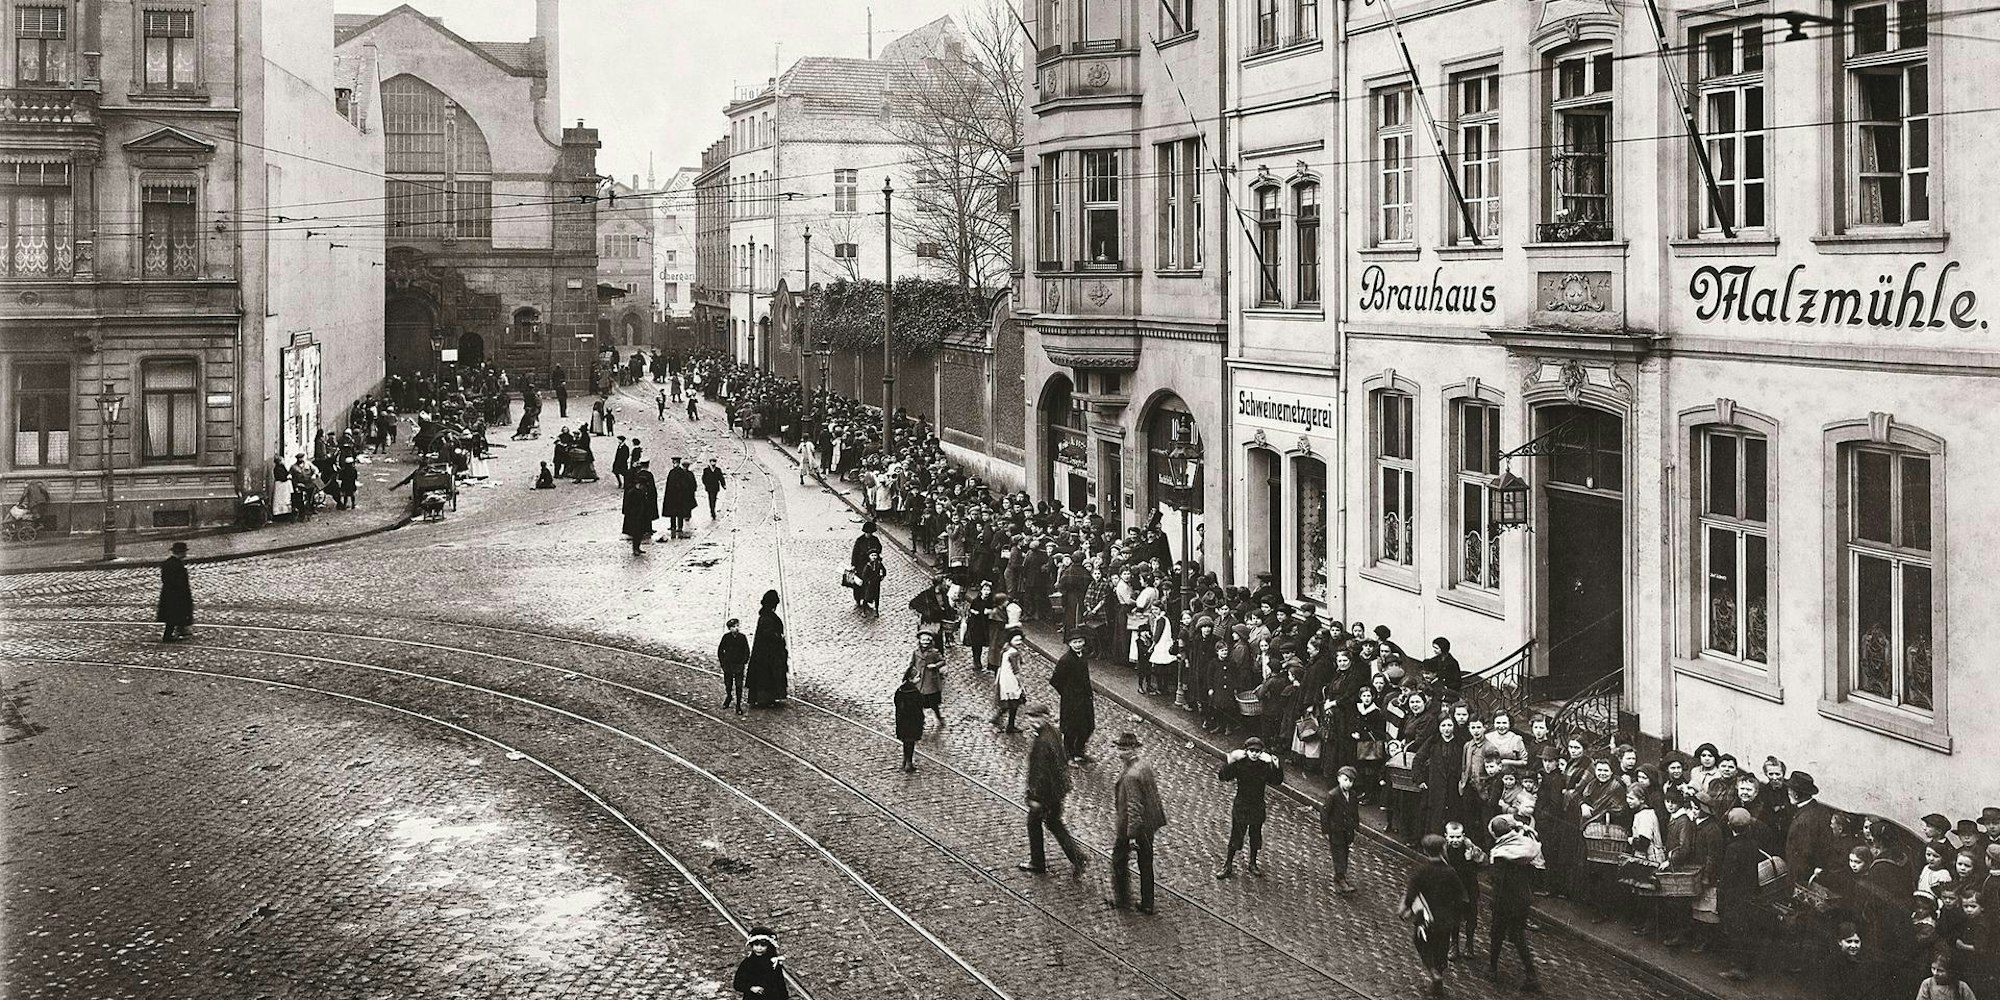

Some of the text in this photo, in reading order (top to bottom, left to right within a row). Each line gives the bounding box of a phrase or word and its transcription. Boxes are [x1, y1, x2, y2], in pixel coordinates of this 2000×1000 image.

[1359, 261, 1988, 329] Brauhaus Malzmühle.
[1239, 390, 1332, 431] Schweinemetzgerei
